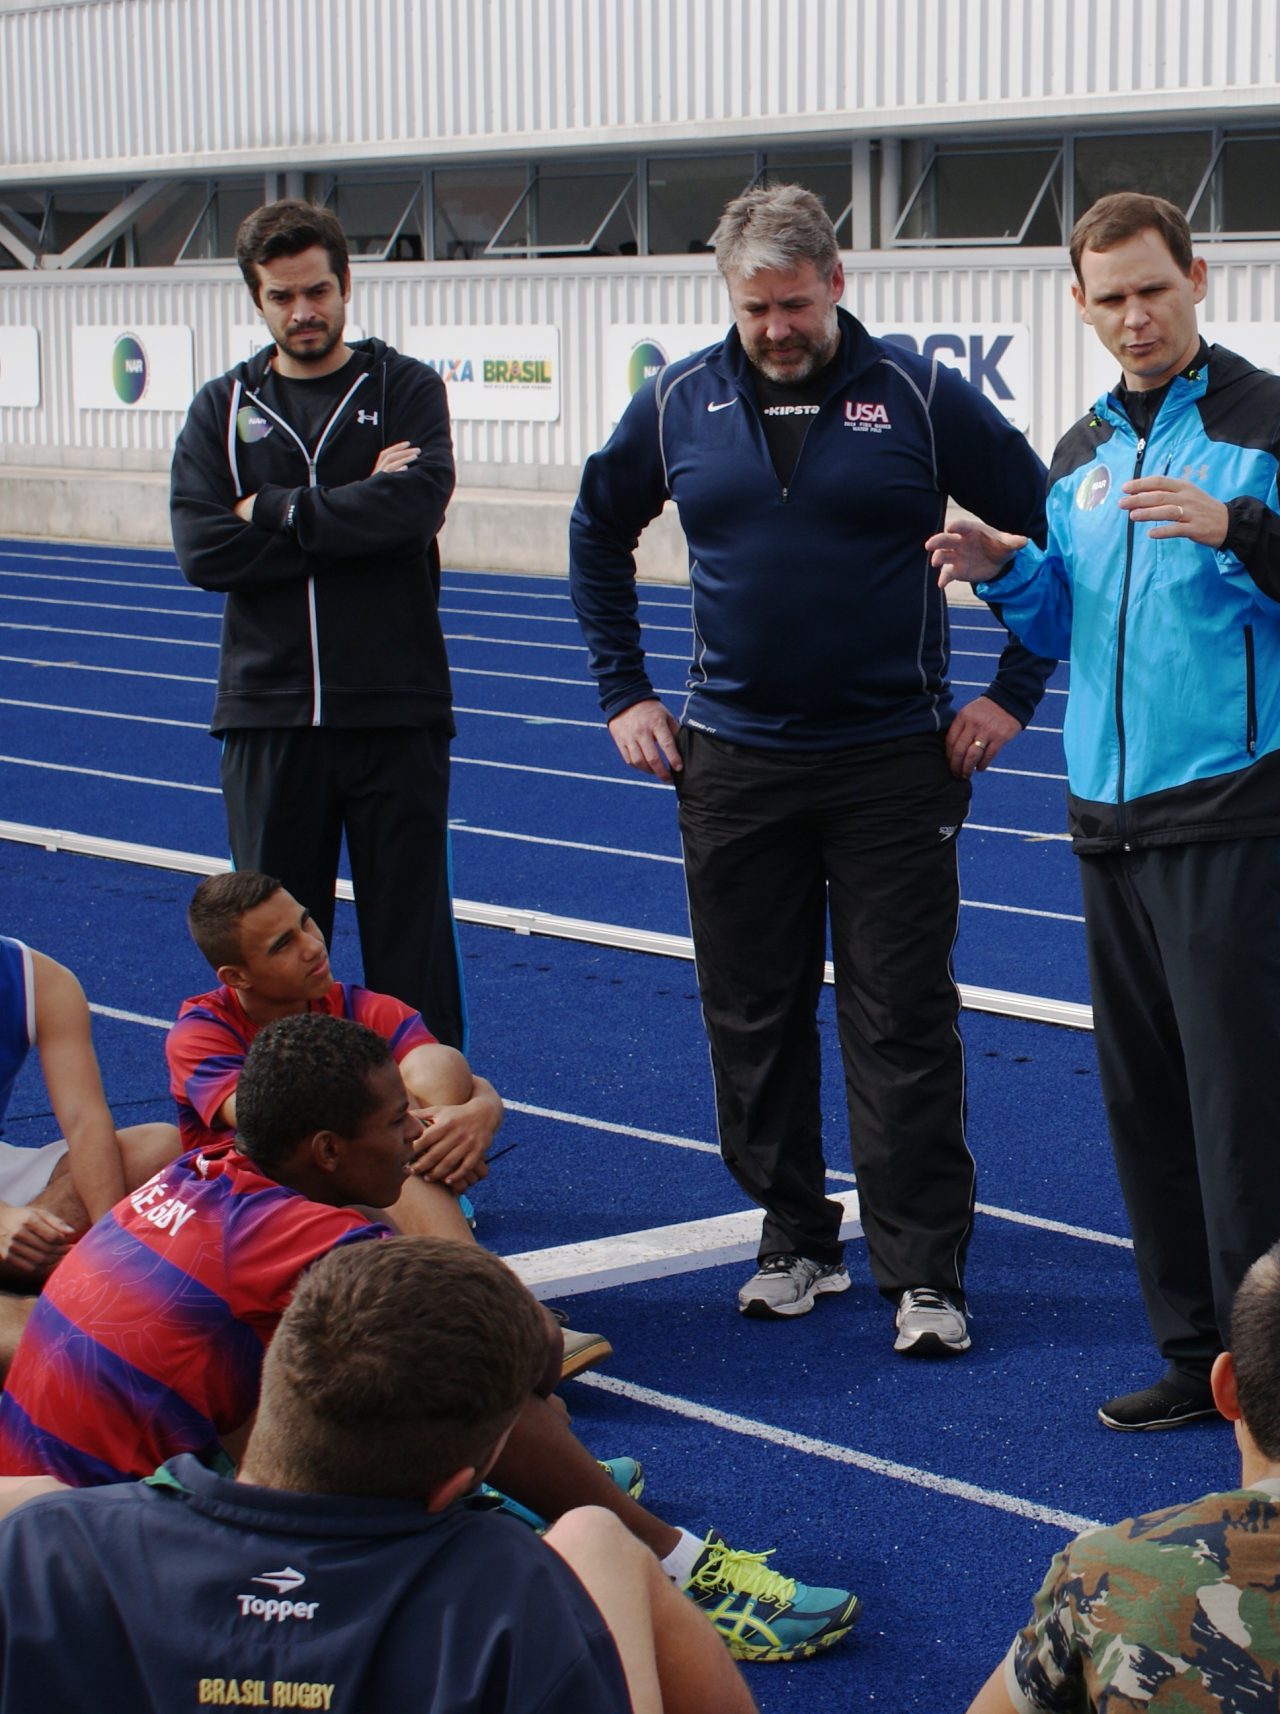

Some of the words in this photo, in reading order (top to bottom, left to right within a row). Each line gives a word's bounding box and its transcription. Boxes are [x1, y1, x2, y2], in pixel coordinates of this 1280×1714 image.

[483, 360, 552, 383] BRASIL
[845, 401, 889, 423] USA
[236, 1594, 320, 1623] Topper
[199, 1677, 270, 1706] BRASIL
[272, 1680, 336, 1711] RUGBY
